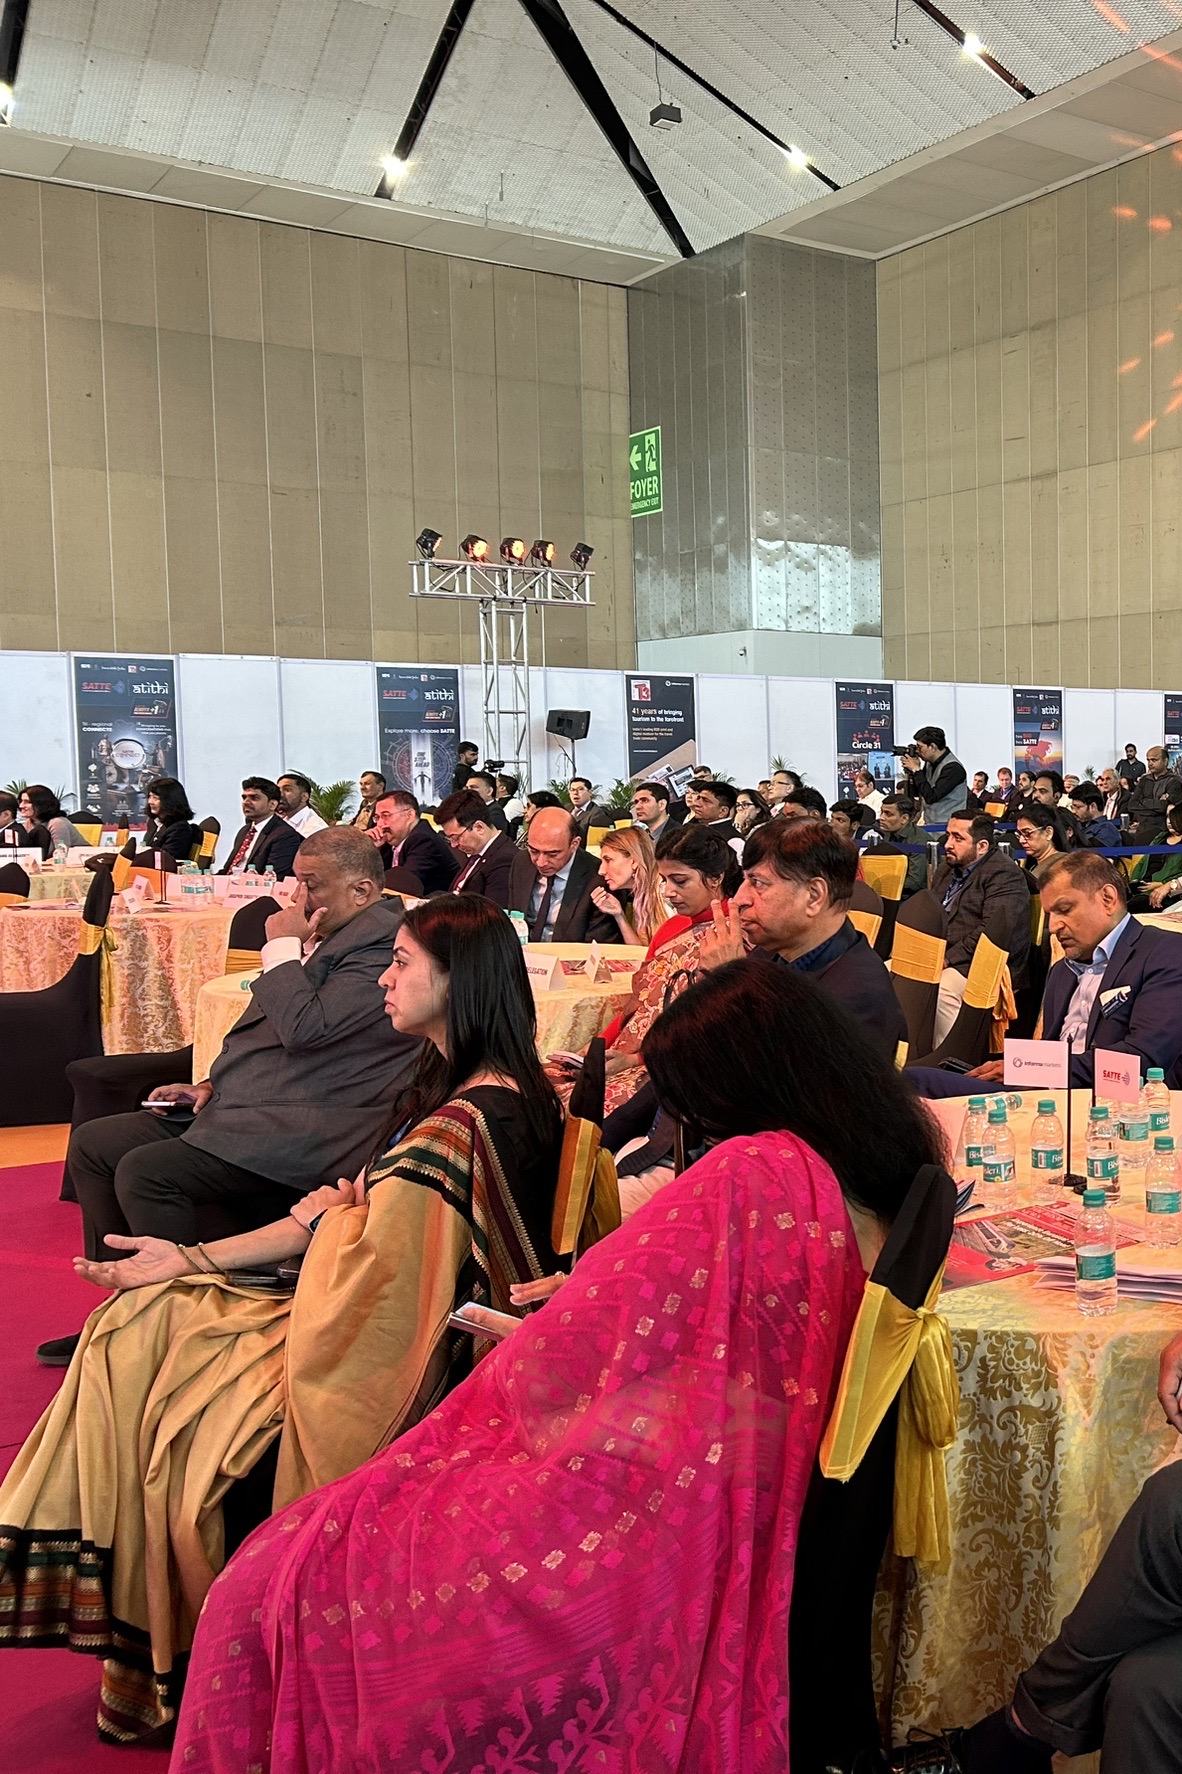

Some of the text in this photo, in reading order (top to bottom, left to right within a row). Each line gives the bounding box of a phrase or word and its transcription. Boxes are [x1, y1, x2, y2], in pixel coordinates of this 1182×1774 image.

[630, 476, 659, 500] FOYER
[82, 682, 112, 690] SATTE
[132, 680, 168, 694] atithi
[424, 688, 454, 700] atithi
[1103, 1070, 1121, 1080] SATTE
